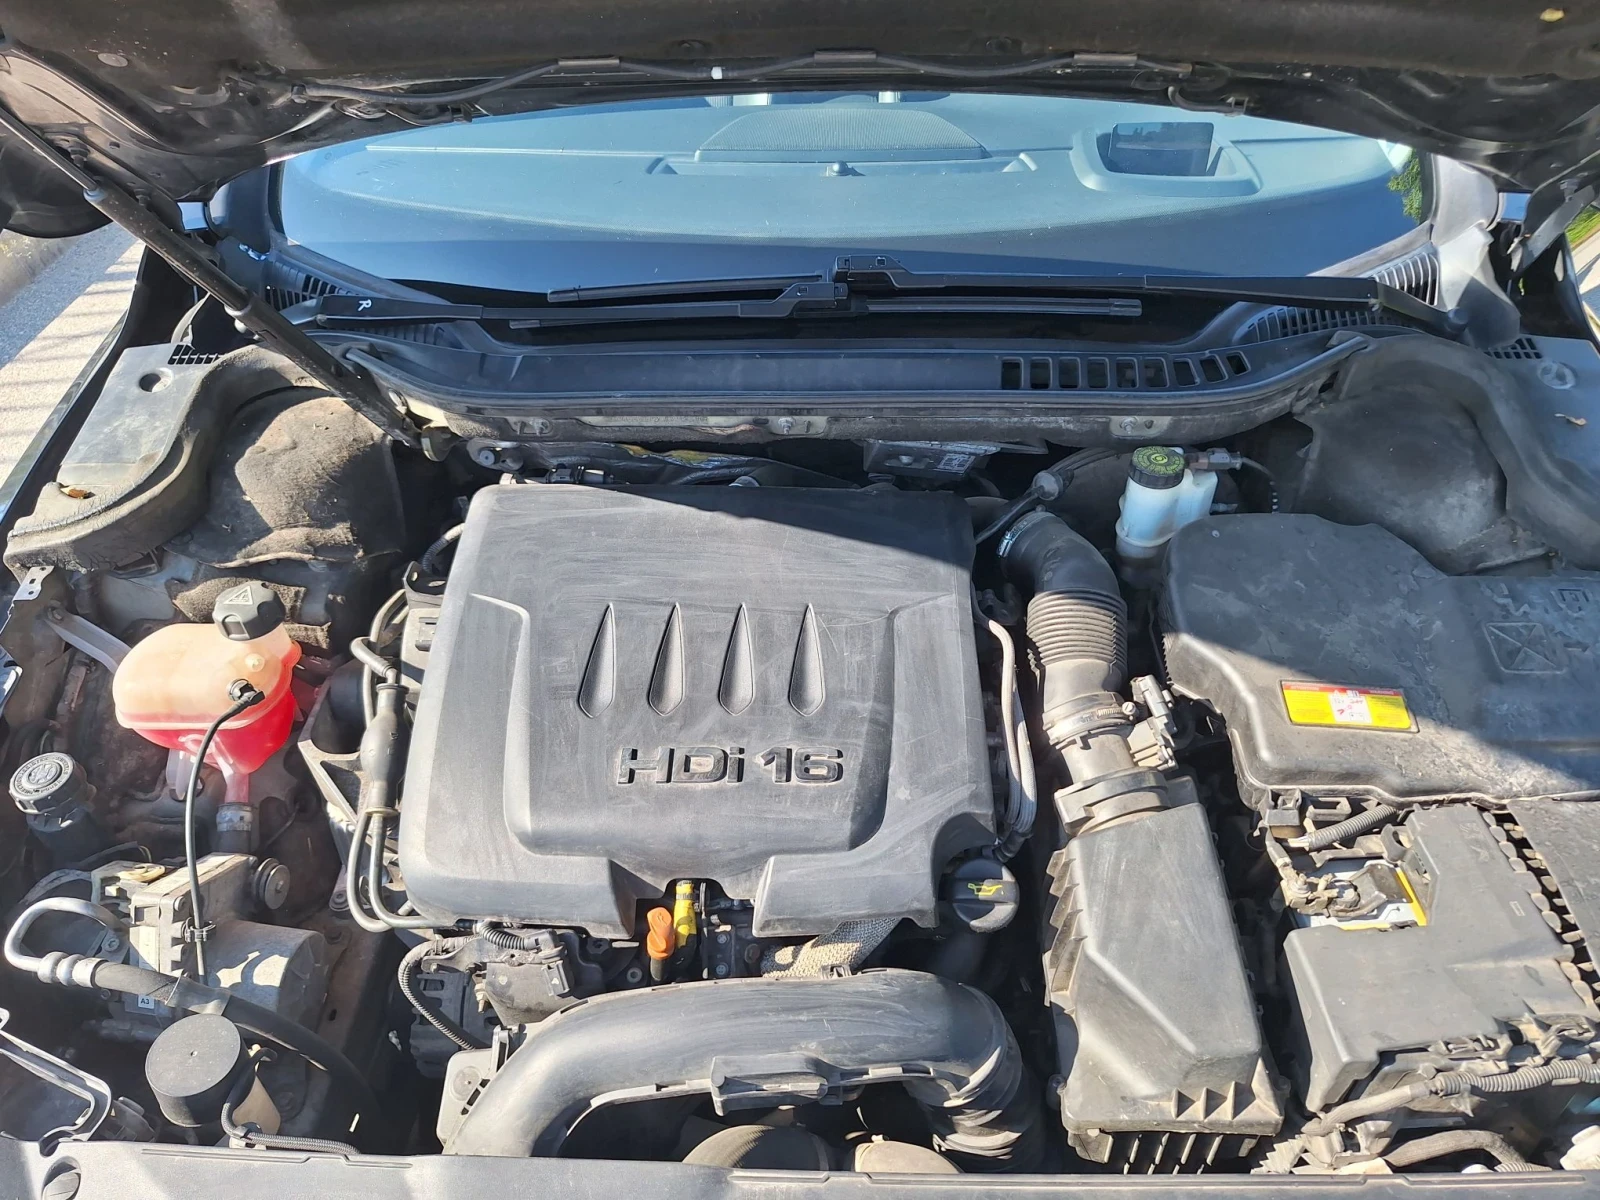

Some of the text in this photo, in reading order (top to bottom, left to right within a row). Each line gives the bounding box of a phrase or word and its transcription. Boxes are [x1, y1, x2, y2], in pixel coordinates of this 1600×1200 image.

[358, 299, 372, 311] R
[617, 747, 844, 784] HDi 16
